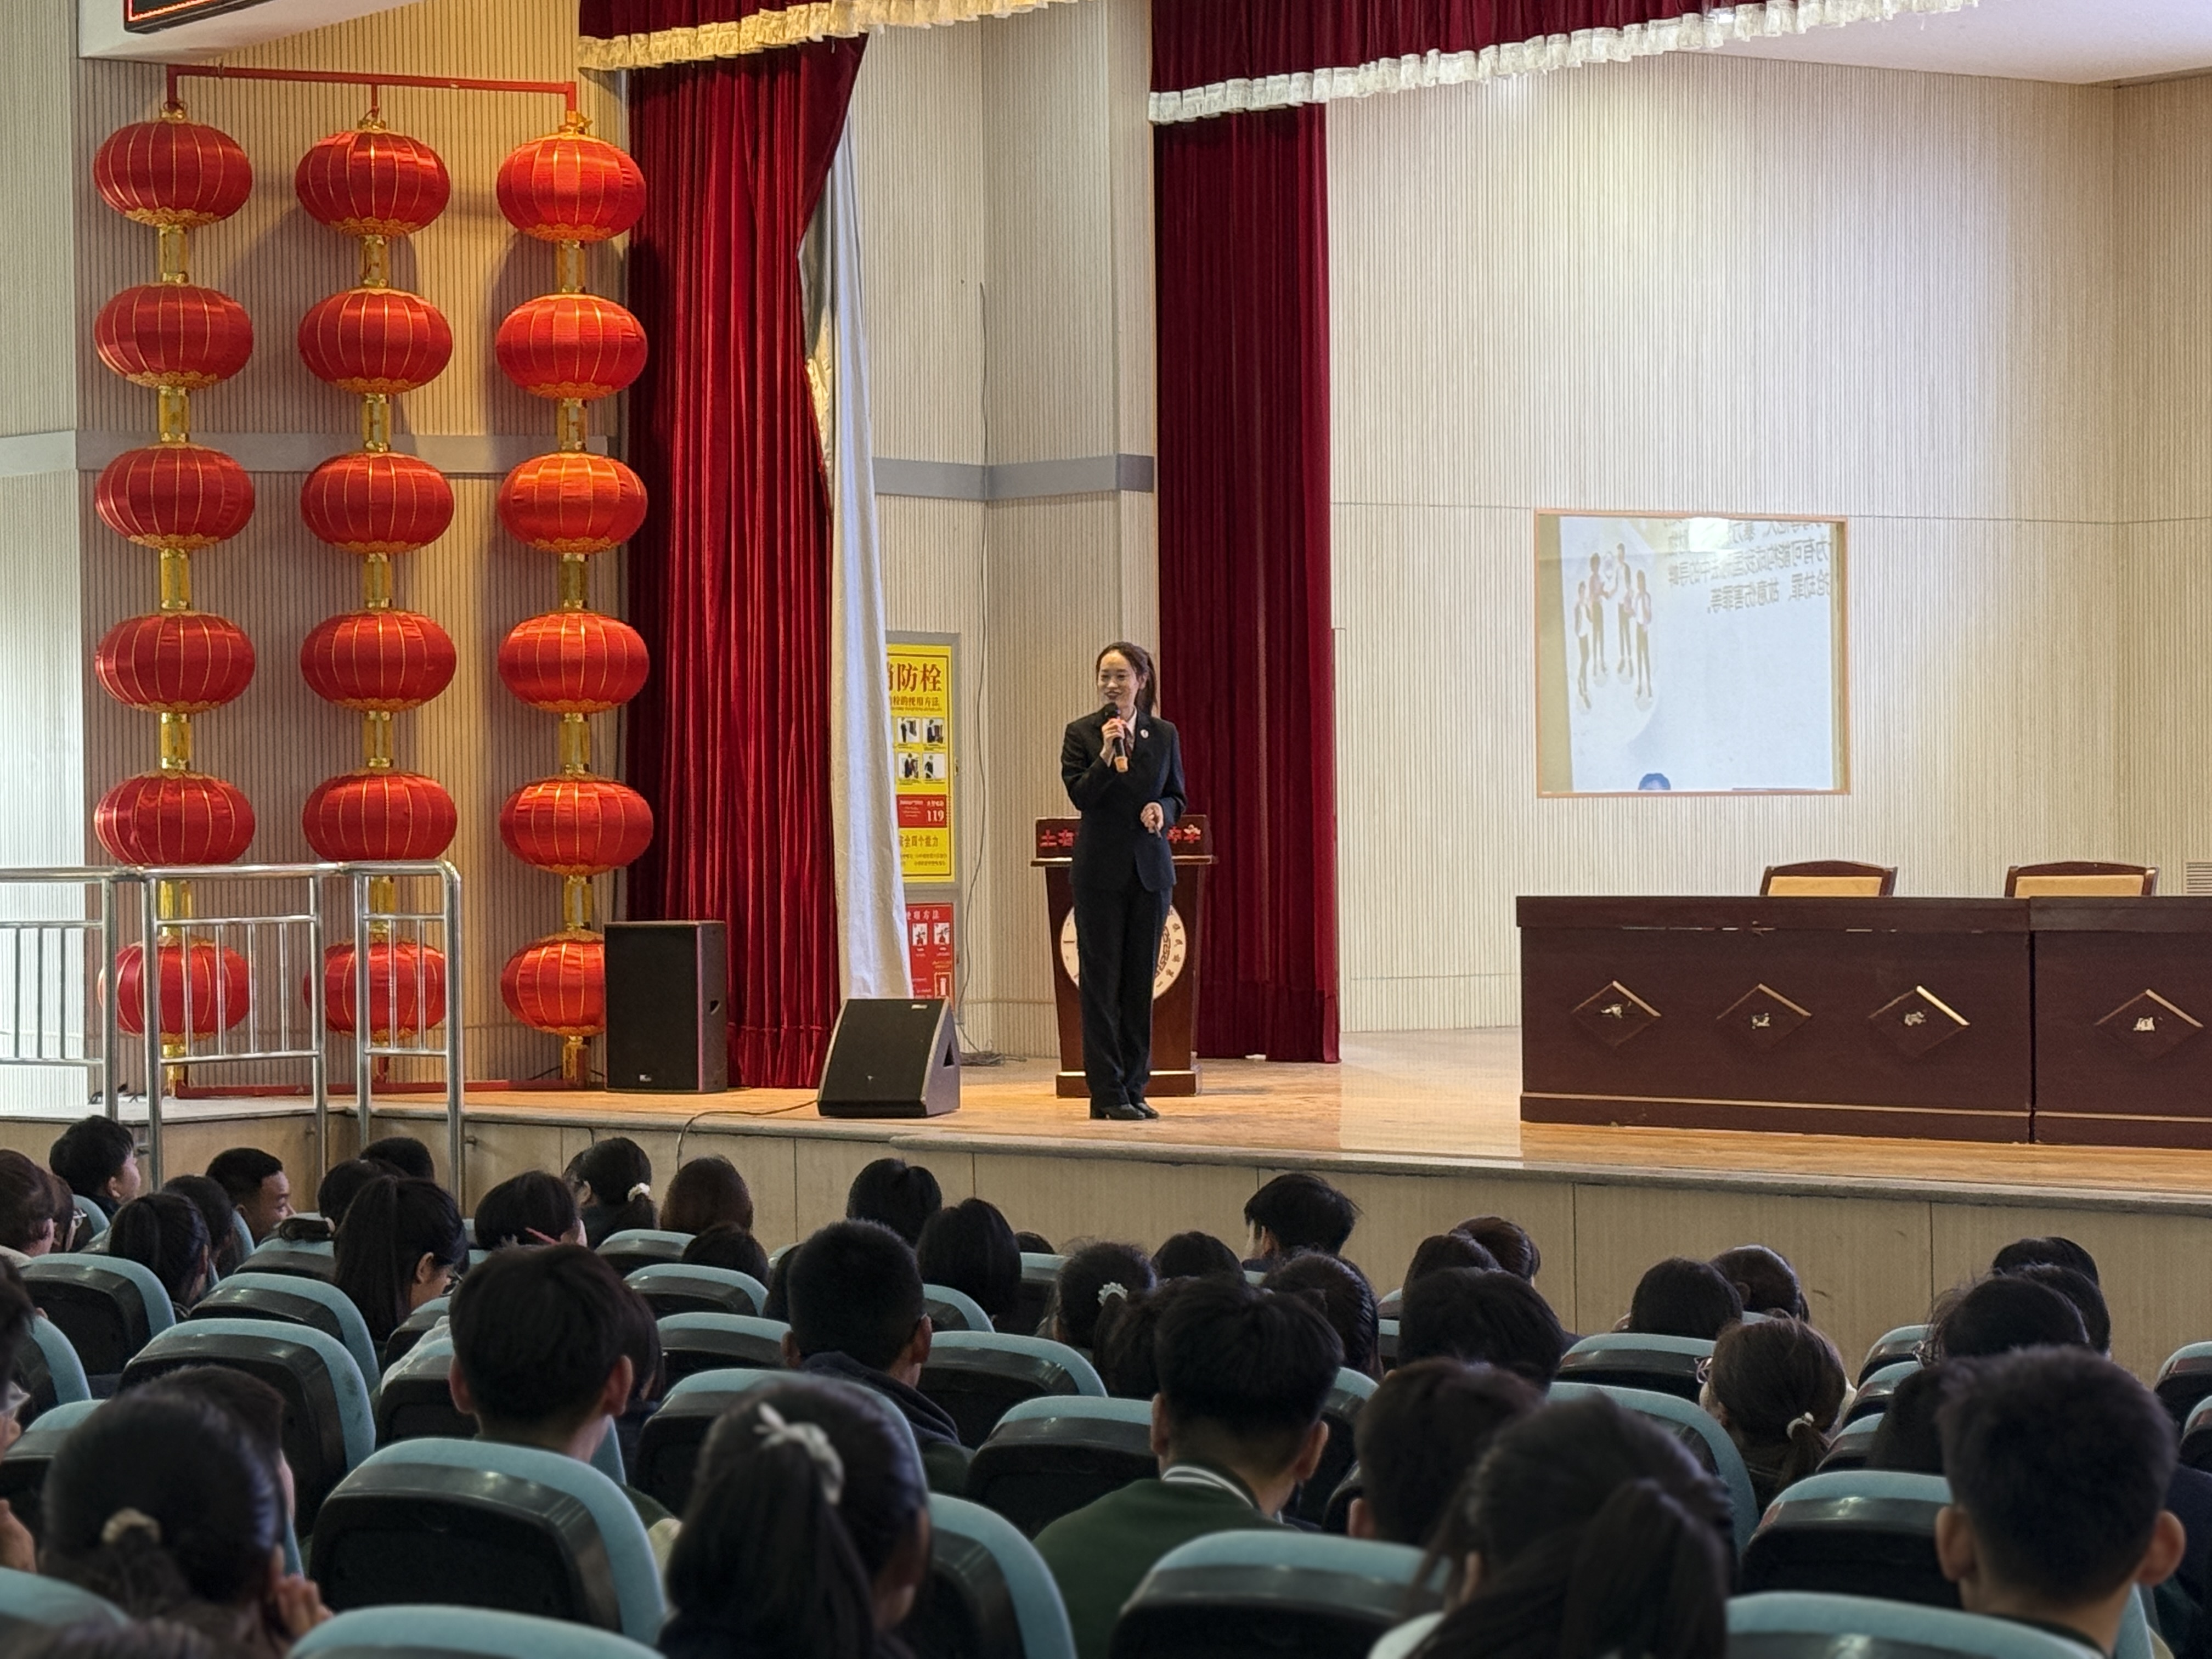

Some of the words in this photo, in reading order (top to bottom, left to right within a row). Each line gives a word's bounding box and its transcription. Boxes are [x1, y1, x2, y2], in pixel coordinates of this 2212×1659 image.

[889, 696, 939, 707] 栓的使用方法
[927, 810, 944, 822] 119
